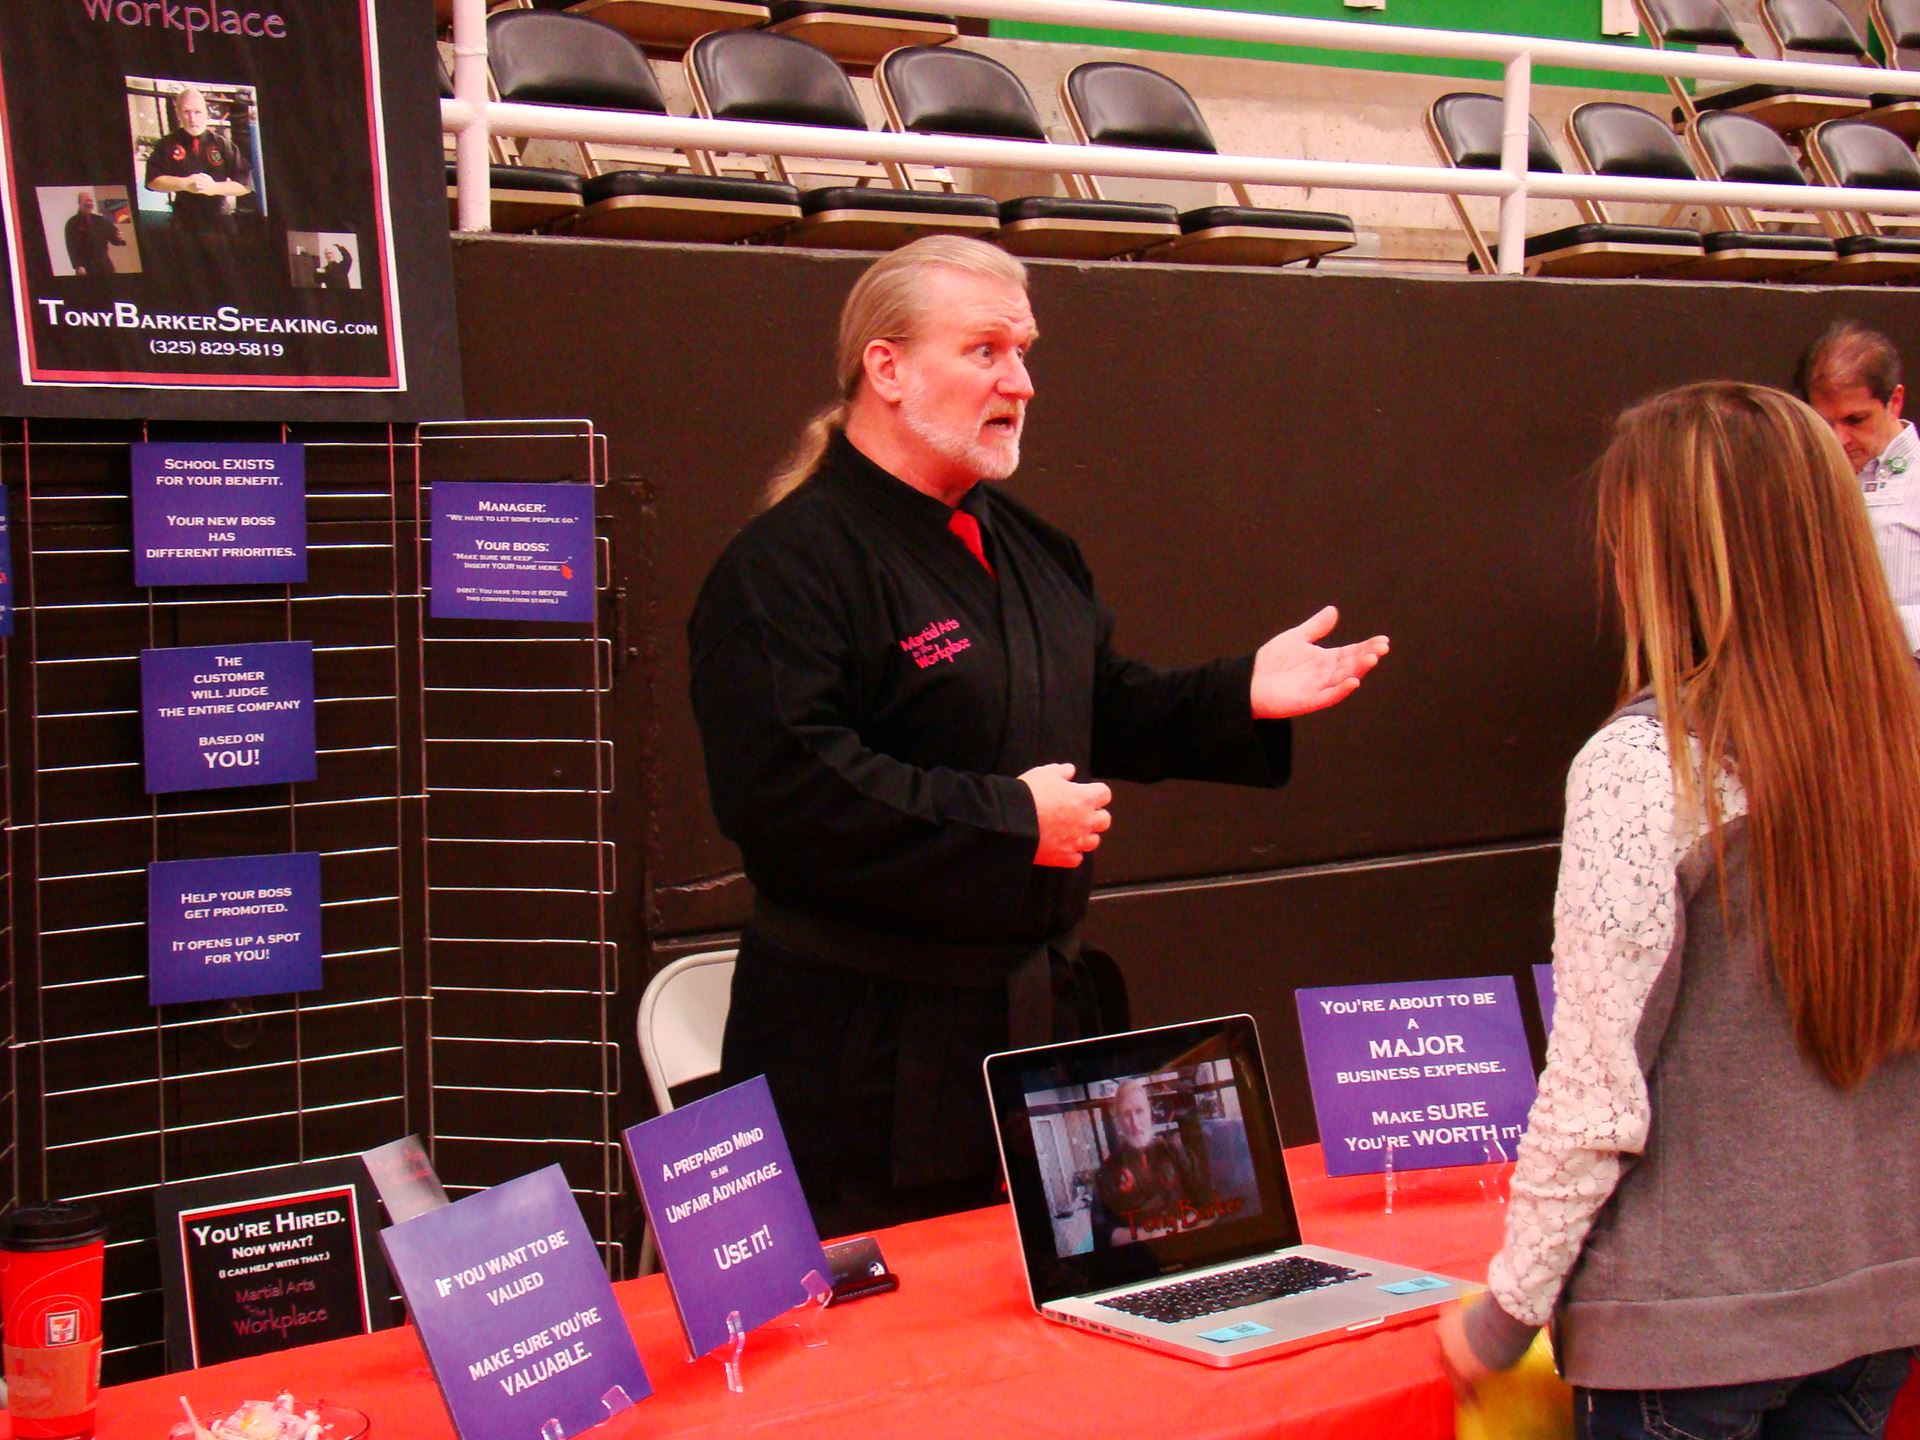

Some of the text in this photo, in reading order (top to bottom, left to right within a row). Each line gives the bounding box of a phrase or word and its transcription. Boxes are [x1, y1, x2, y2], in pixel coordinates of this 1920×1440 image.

[82, 0, 287, 53] Workplace
[149, 340, 284, 357] (325) 829-5819
[165, 459, 275, 470] SCHOOL EXISTS
[156, 476, 283, 486] FOR YOUR BENEFIT.
[478, 501, 546, 512] MANAGER:
[167, 515, 275, 526] YOUR NEW BOSS
[208, 533, 235, 541] HAS
[475, 539, 549, 552] YOUR BOSS:
[146, 548, 296, 558] DIFFERENT PRIORITIES.
[900, 622, 940, 651] Martial
[215, 656, 243, 667] THE
[916, 638, 971, 668] Workplace
[193, 672, 265, 683] CUSTOMER
[191, 687, 269, 699] WILL JUDGE
[158, 700, 301, 717] THE ENTIRE COMPANY
[199, 733, 264, 746] BASED ON
[204, 750, 260, 769] YOU!
[181, 887, 292, 904] HELP YOUR BOSS
[184, 904, 288, 919] GET PROMOTED.
[173, 933, 301, 951] IT OPENS UP A SPOT
[205, 949, 270, 964] FOR YOU!
[1320, 992, 1496, 1015] YOU'RE ABOUT TO BE
[1407, 1018, 1419, 1030] A
[1369, 1035, 1466, 1059] MAJOR
[1336, 1061, 1506, 1084] BUSINESS EXPENSE.
[1372, 1102, 1488, 1125] MAKE SURE
[1344, 1133, 1411, 1151] YOU'RE
[1411, 1124, 1498, 1146] WORTH
[663, 1127, 764, 1182] A PREPARED MIND
[710, 1165, 729, 1179] IS AN
[665, 1162, 783, 1223] UNFAIR ADVANTAGE.
[192, 1210, 346, 1246] YOU'RE HIRED.
[232, 1235, 314, 1259] NOW WHAT?
[714, 1224, 773, 1270] USE IT!
[227, 1267, 248, 1277] CAN
[249, 1262, 275, 1273] HELP
[275, 1258, 299, 1269] WITH
[300, 1252, 330, 1265] THAT.)
[435, 1230, 569, 1298] IF YOU WANT TO BE
[235, 1278, 315, 1303] Martial Arts
[487, 1272, 544, 1306] VALUED
[234, 1304, 328, 1338] Workplace
[468, 1307, 601, 1381] MAKE SURE YOU'RE
[500, 1342, 592, 1397] VALUABLE.
